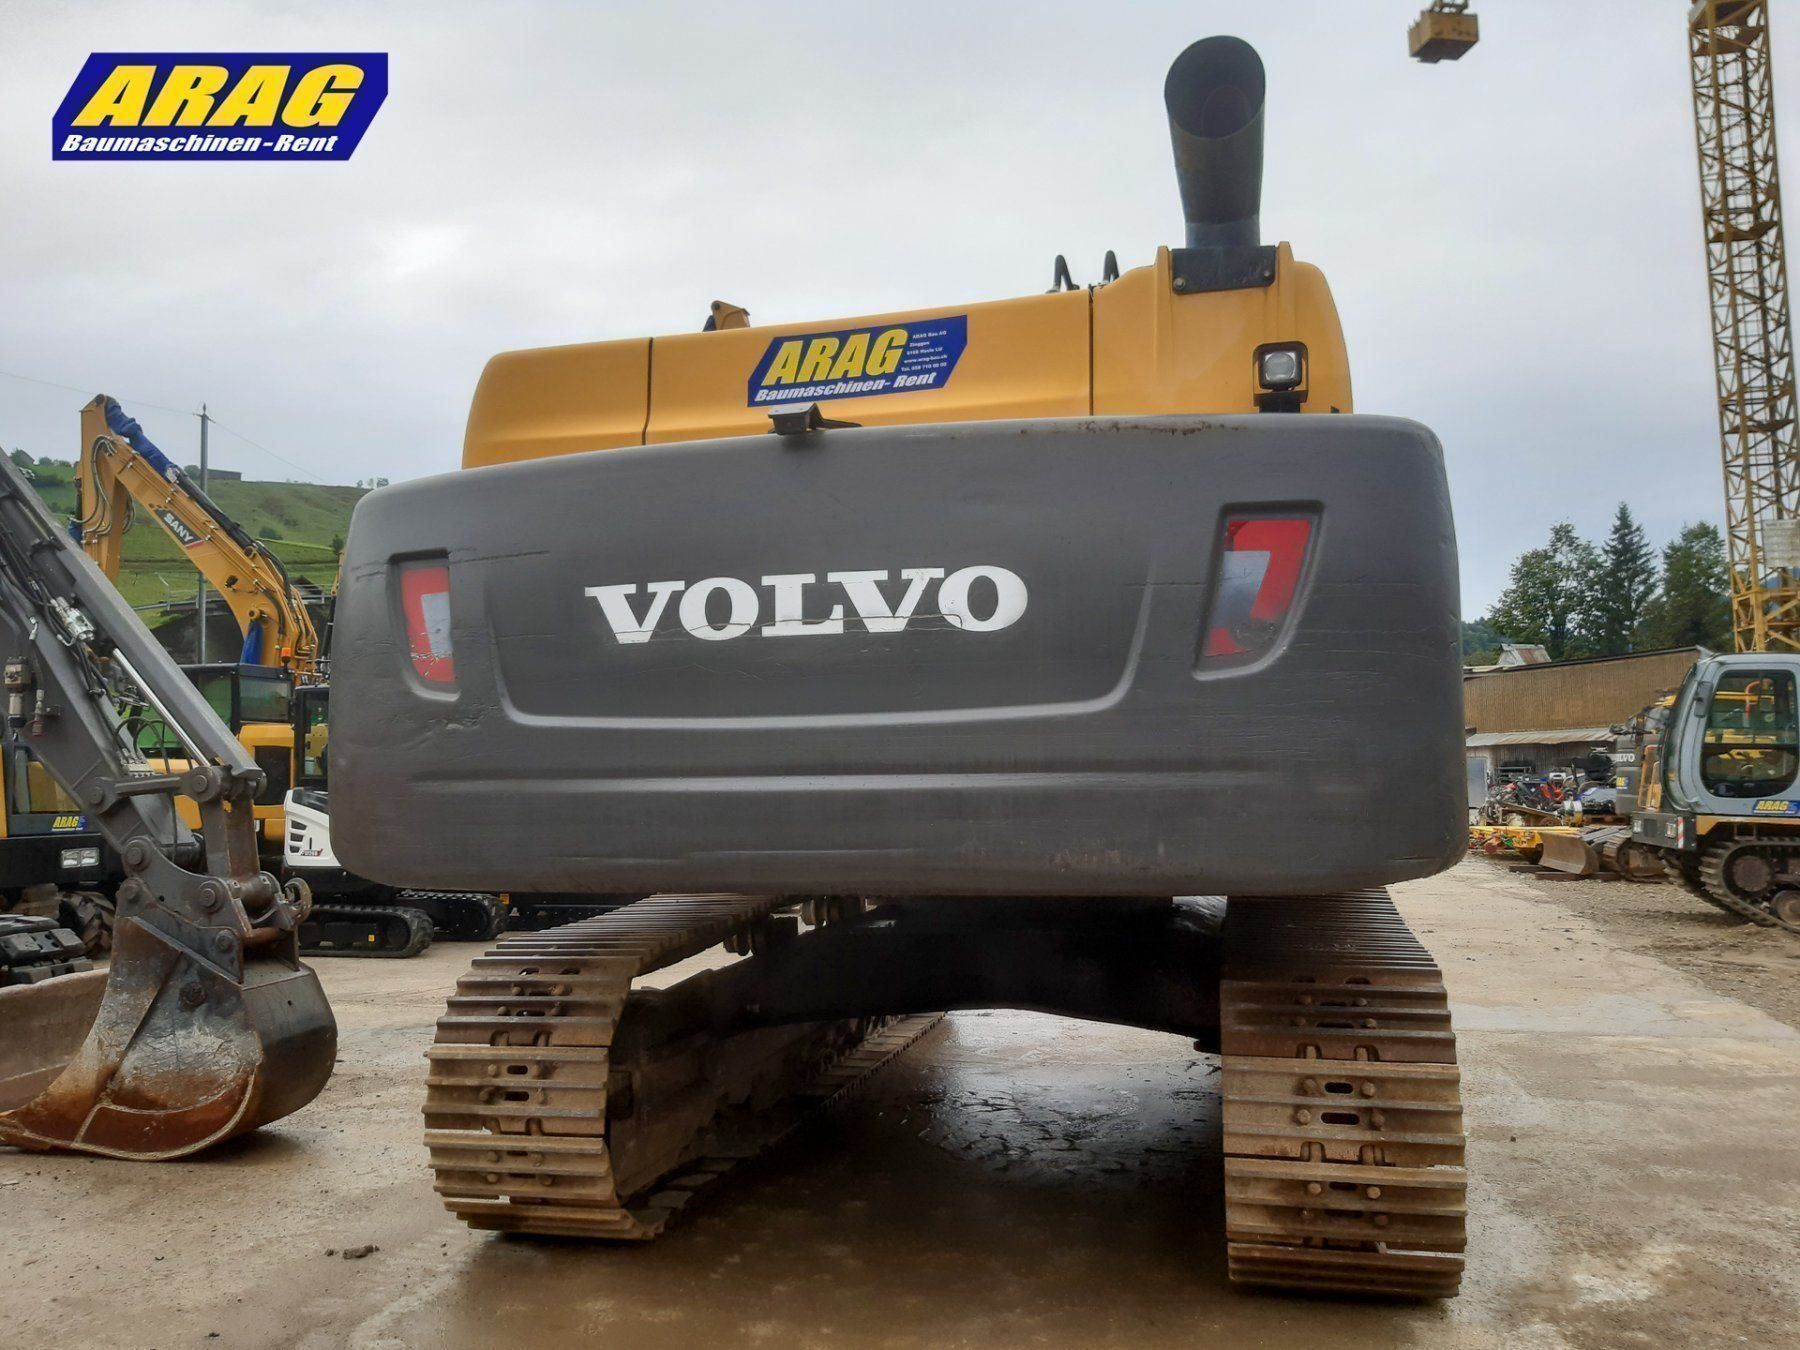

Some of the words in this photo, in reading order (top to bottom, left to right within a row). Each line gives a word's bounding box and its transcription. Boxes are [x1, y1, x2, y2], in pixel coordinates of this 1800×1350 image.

[760, 329, 908, 386] ARAG
[893, 372, 937, 388] Rent
[163, 512, 194, 542] SANY
[584, 565, 1028, 644] VOLVO
[1755, 800, 1789, 810] ARAG
[53, 816, 79, 827] ARAG
